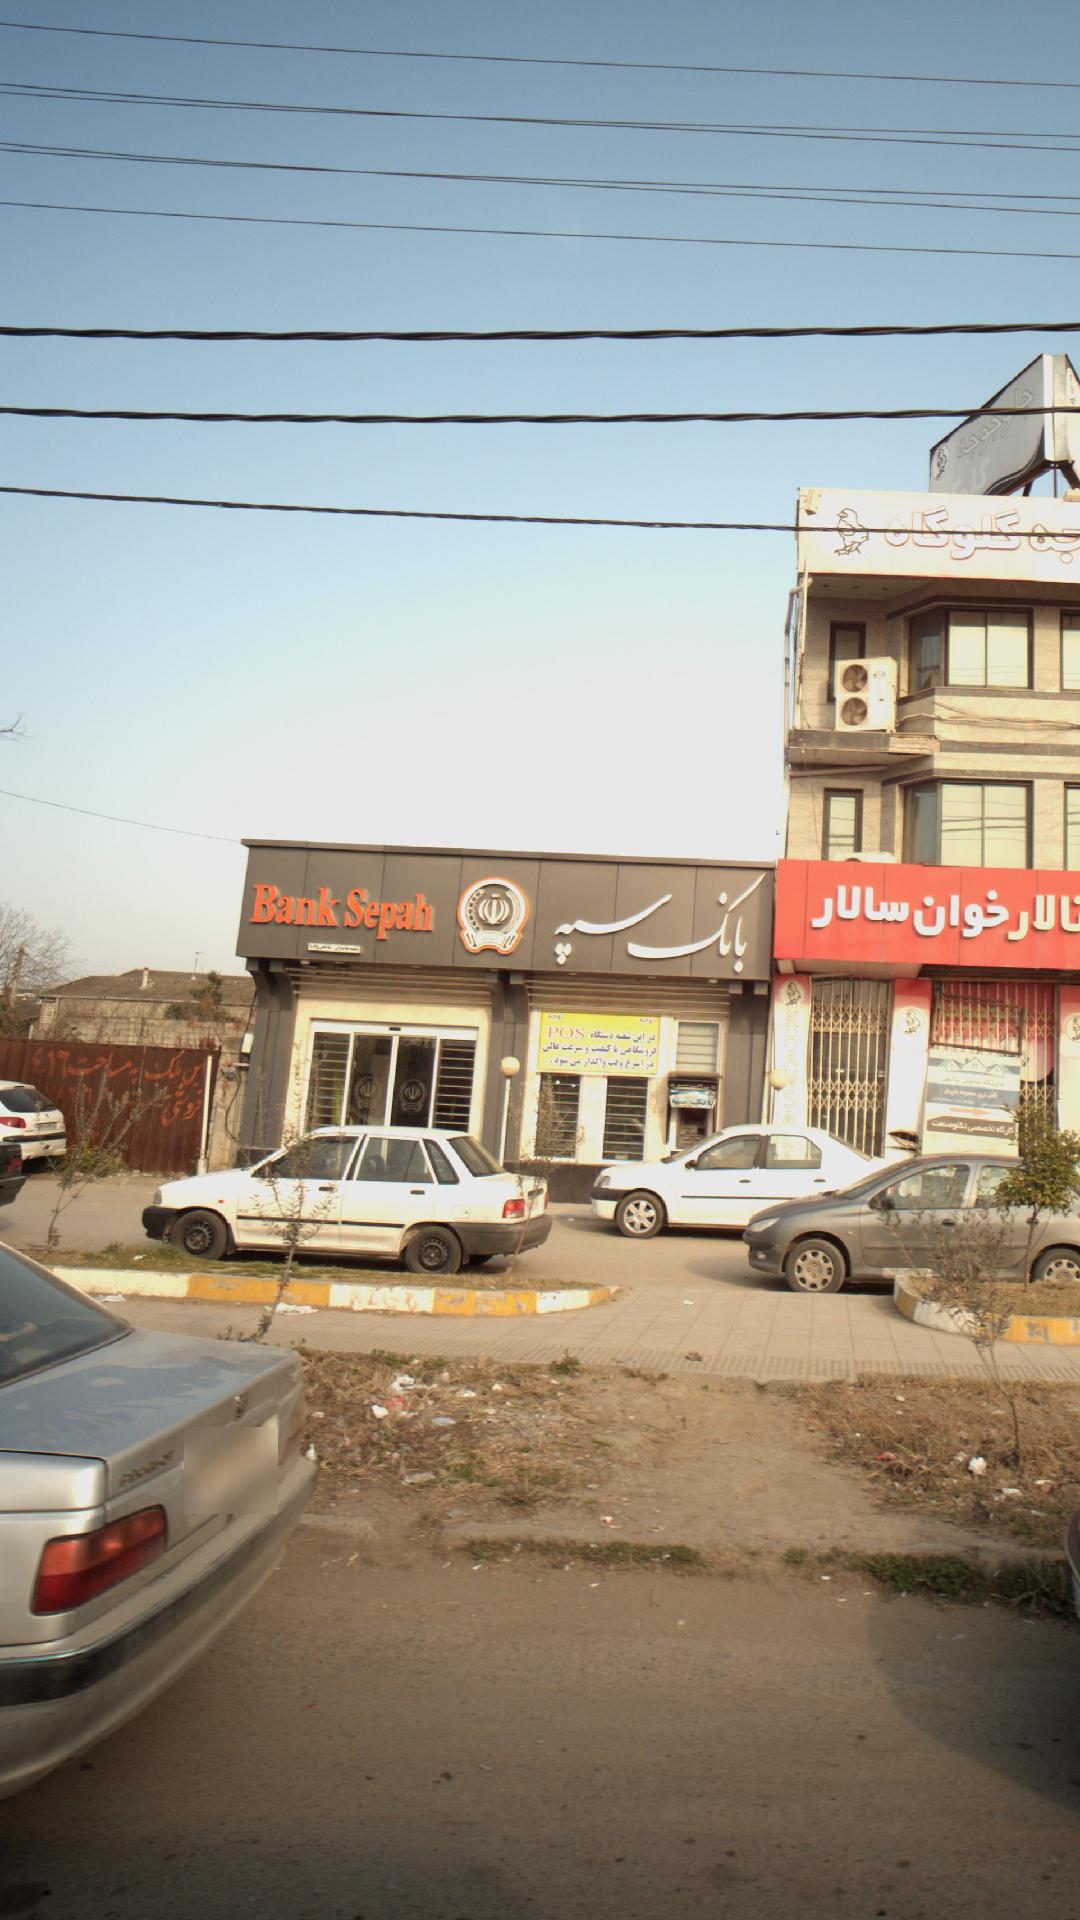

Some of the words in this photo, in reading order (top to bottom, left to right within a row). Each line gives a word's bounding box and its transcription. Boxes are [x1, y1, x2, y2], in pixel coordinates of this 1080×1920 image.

[884, 505, 1021, 560] گلوگاه
[250, 883, 341, 926] Bank
[343, 888, 434, 940] Sepah
[555, 894, 672, 965] سپه
[628, 873, 765, 973] بانک
[811, 886, 909, 928] سالار
[913, 889, 1009, 937] خوان
[548, 1025, 585, 1040] POS
